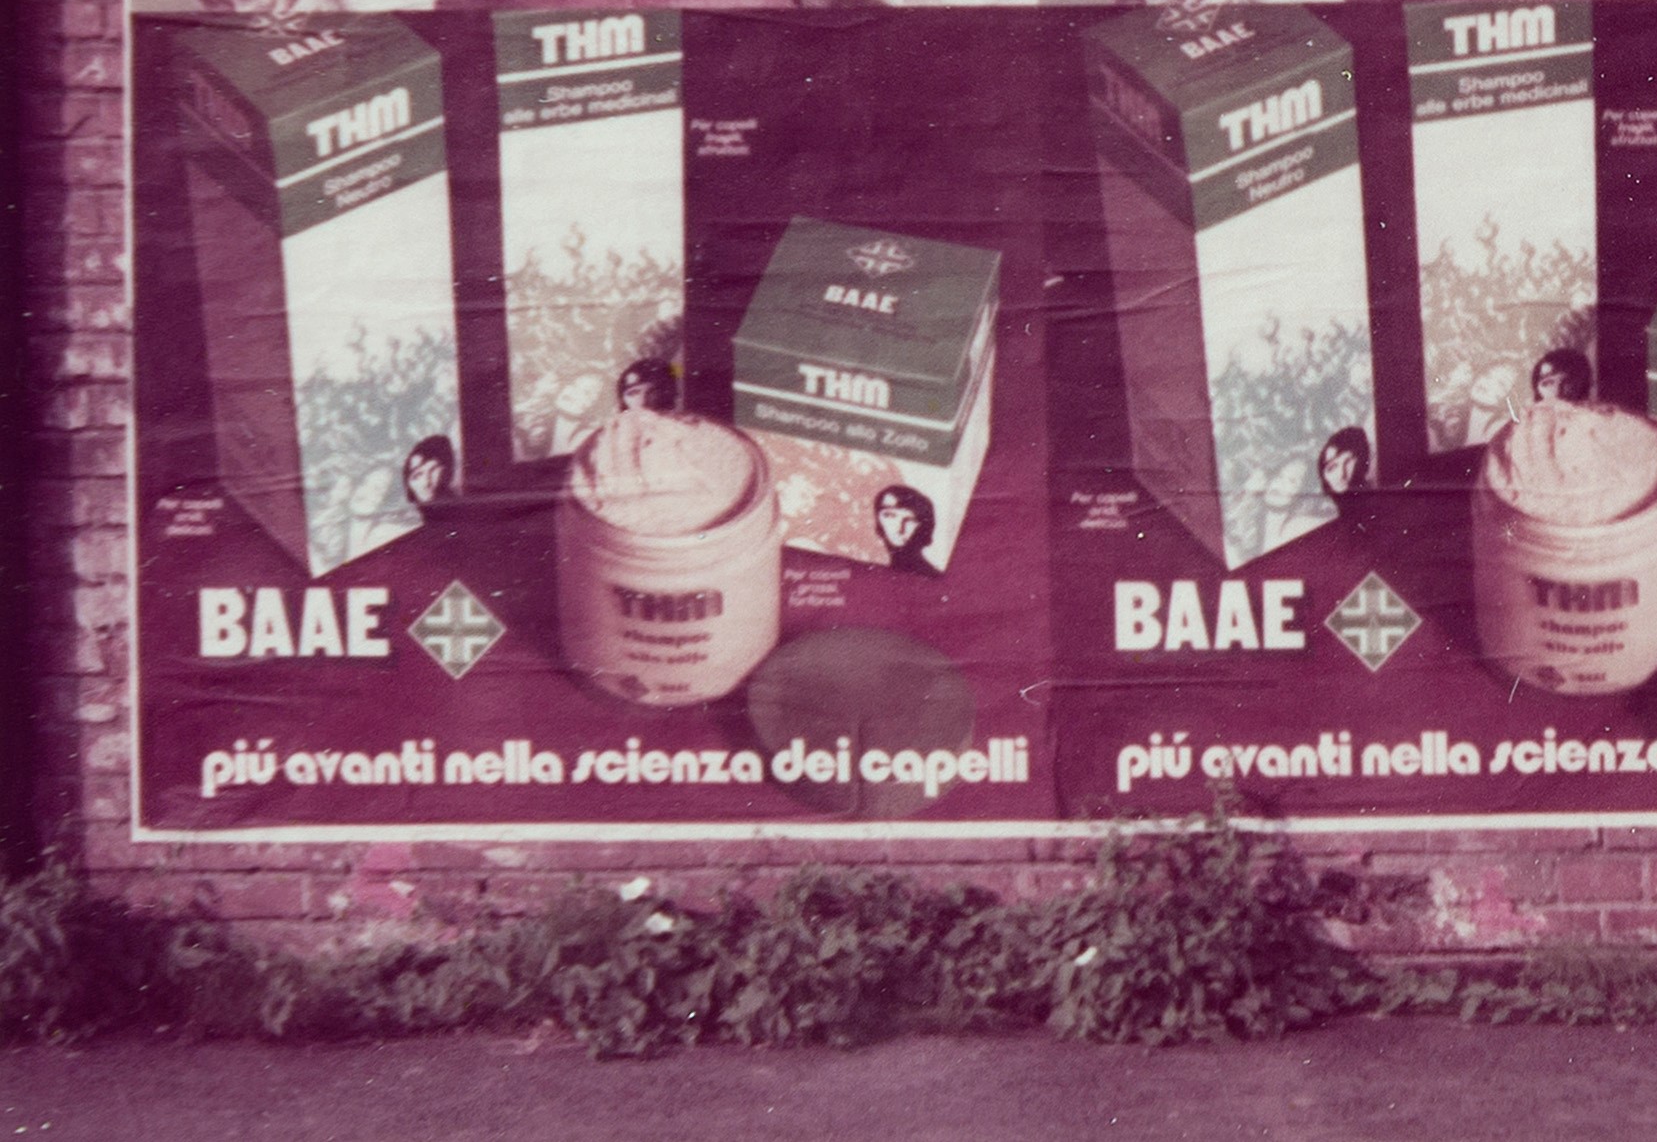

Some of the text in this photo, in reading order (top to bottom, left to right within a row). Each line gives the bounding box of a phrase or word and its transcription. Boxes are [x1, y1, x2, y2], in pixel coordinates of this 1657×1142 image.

[532, 14, 645, 64] THM
[1180, 22, 1255, 59] BAAE
[1444, 4, 1555, 56] THM
[547, 80, 634, 101] Shampoo
[1452, 93, 1494, 111] erbe
[1458, 71, 1545, 94] Shampoo
[306, 87, 411, 157] THM
[540, 103, 582, 120] erbe
[1219, 78, 1322, 151] THM
[823, 285, 898, 314] BAAE
[798, 363, 890, 409] THM
[755, 403, 840, 433] Shampoo
[199, 588, 390, 658] BAAE
[1114, 580, 1306, 652] BAAE
[284, 741, 436, 784] avanti
[444, 741, 564, 784] nella
[571, 740, 763, 784] scienza
[771, 738, 851, 784] dei
[859, 737, 1029, 798] capelli
[1201, 731, 1352, 778] avanti
[1362, 730, 1481, 777] nella
